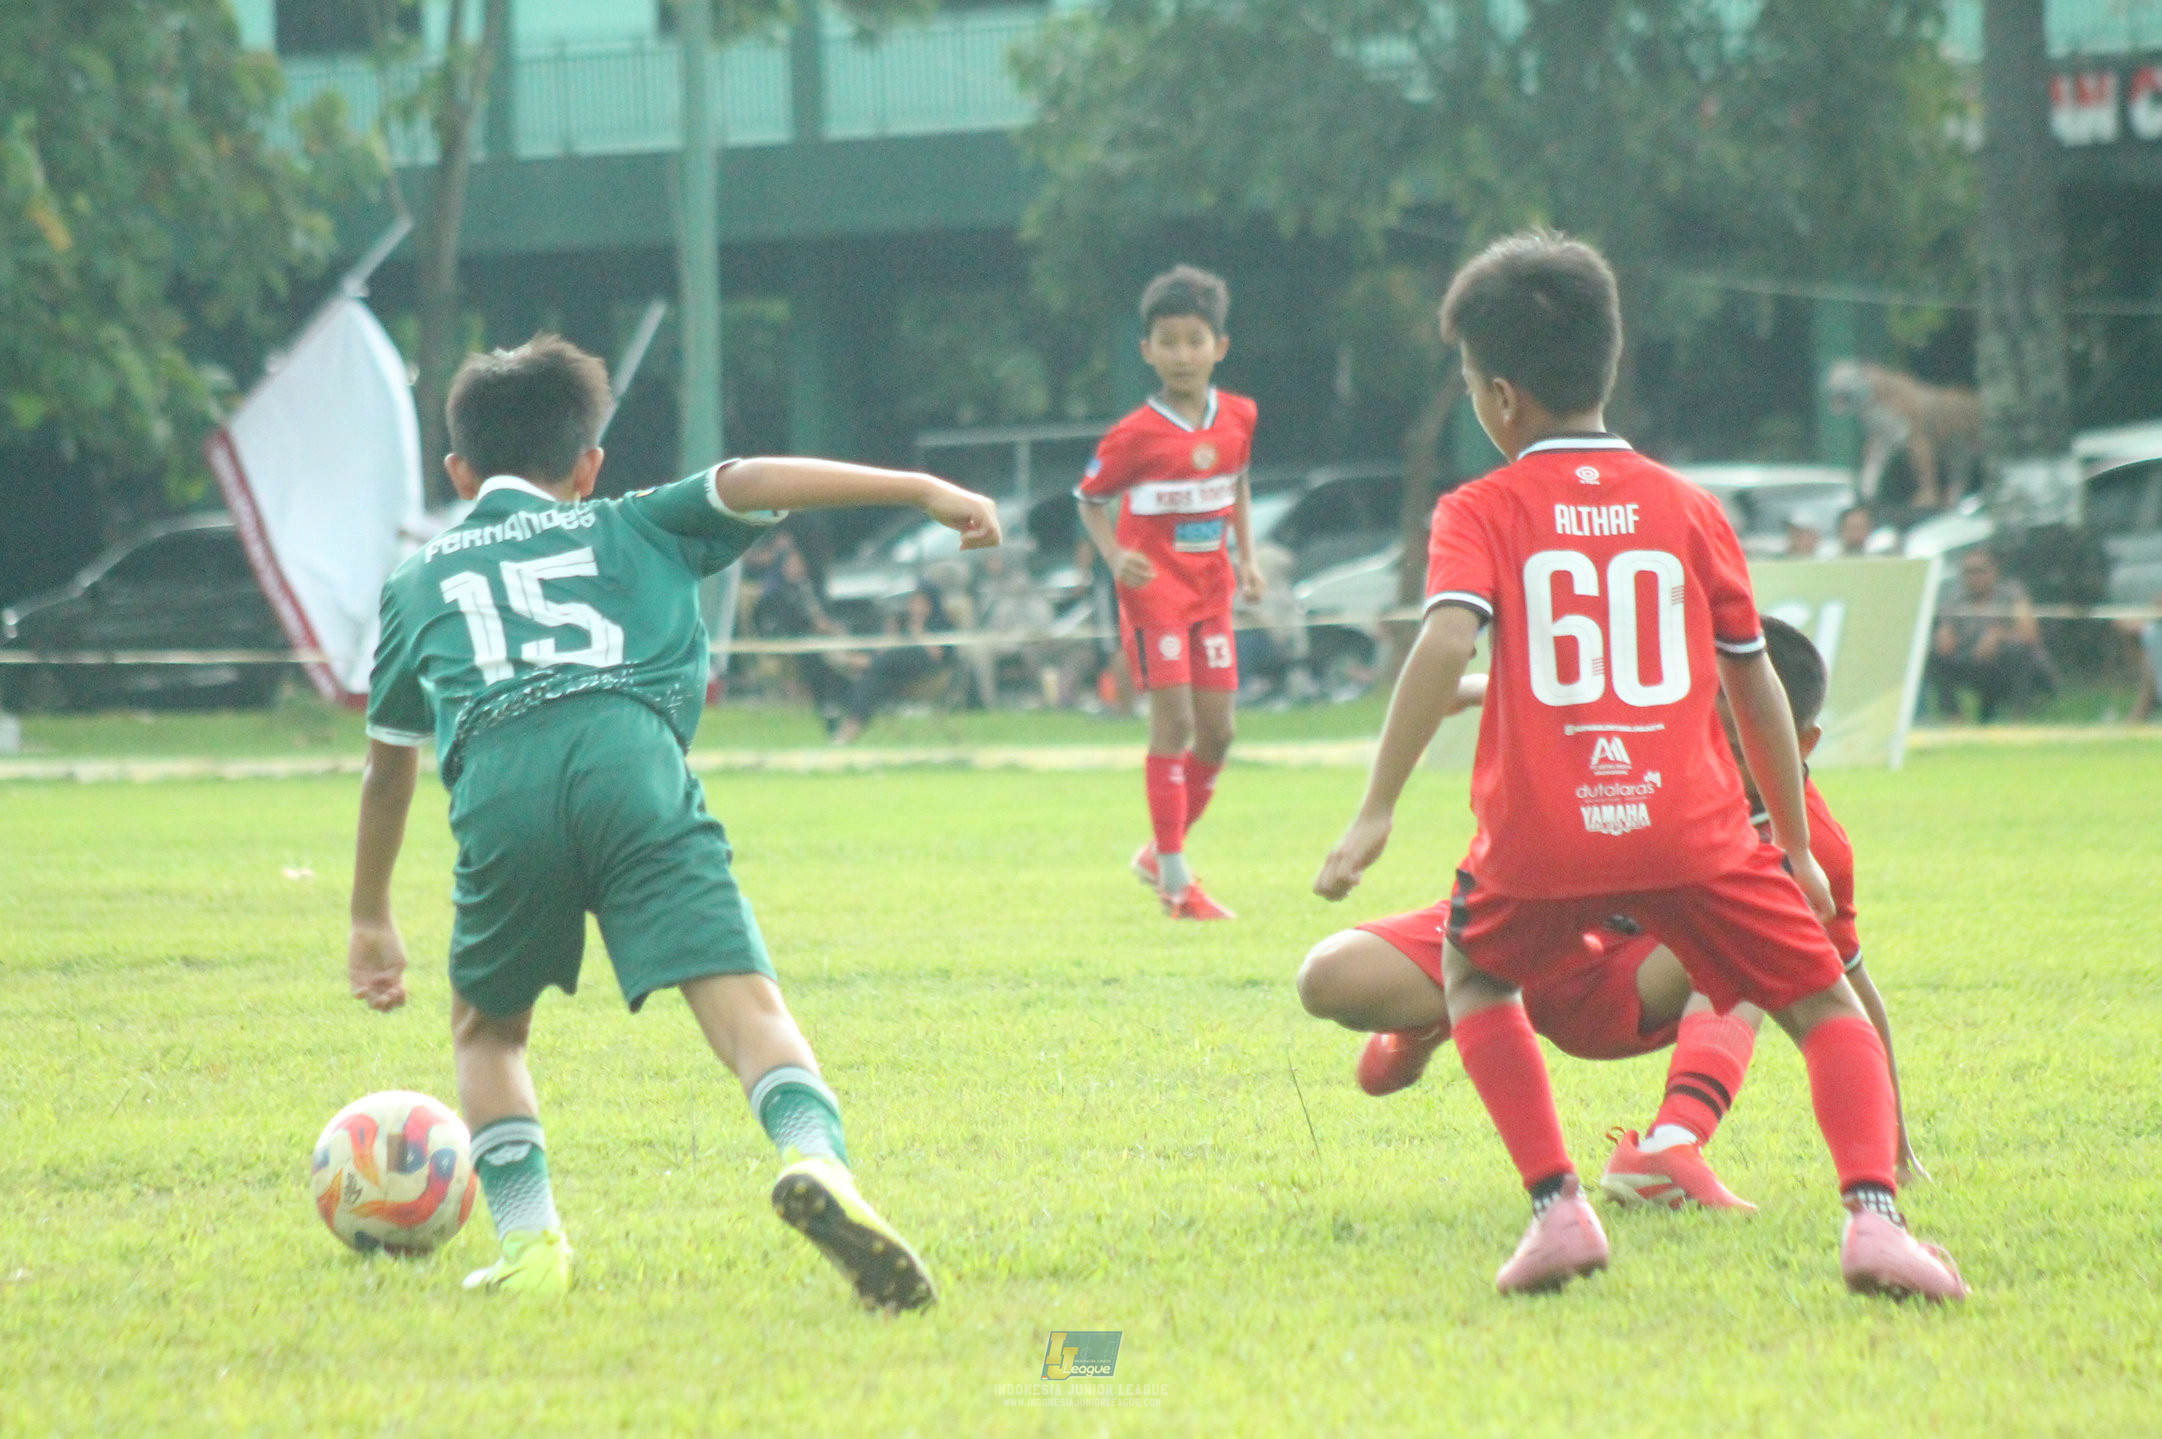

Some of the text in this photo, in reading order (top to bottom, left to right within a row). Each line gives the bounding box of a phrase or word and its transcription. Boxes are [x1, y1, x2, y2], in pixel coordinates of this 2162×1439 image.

[1554, 504, 1640, 536] ALTHAF
[439, 547, 625, 687] 15
[1523, 549, 1691, 707] 60
[1581, 803, 1651, 831] YAMAHA
